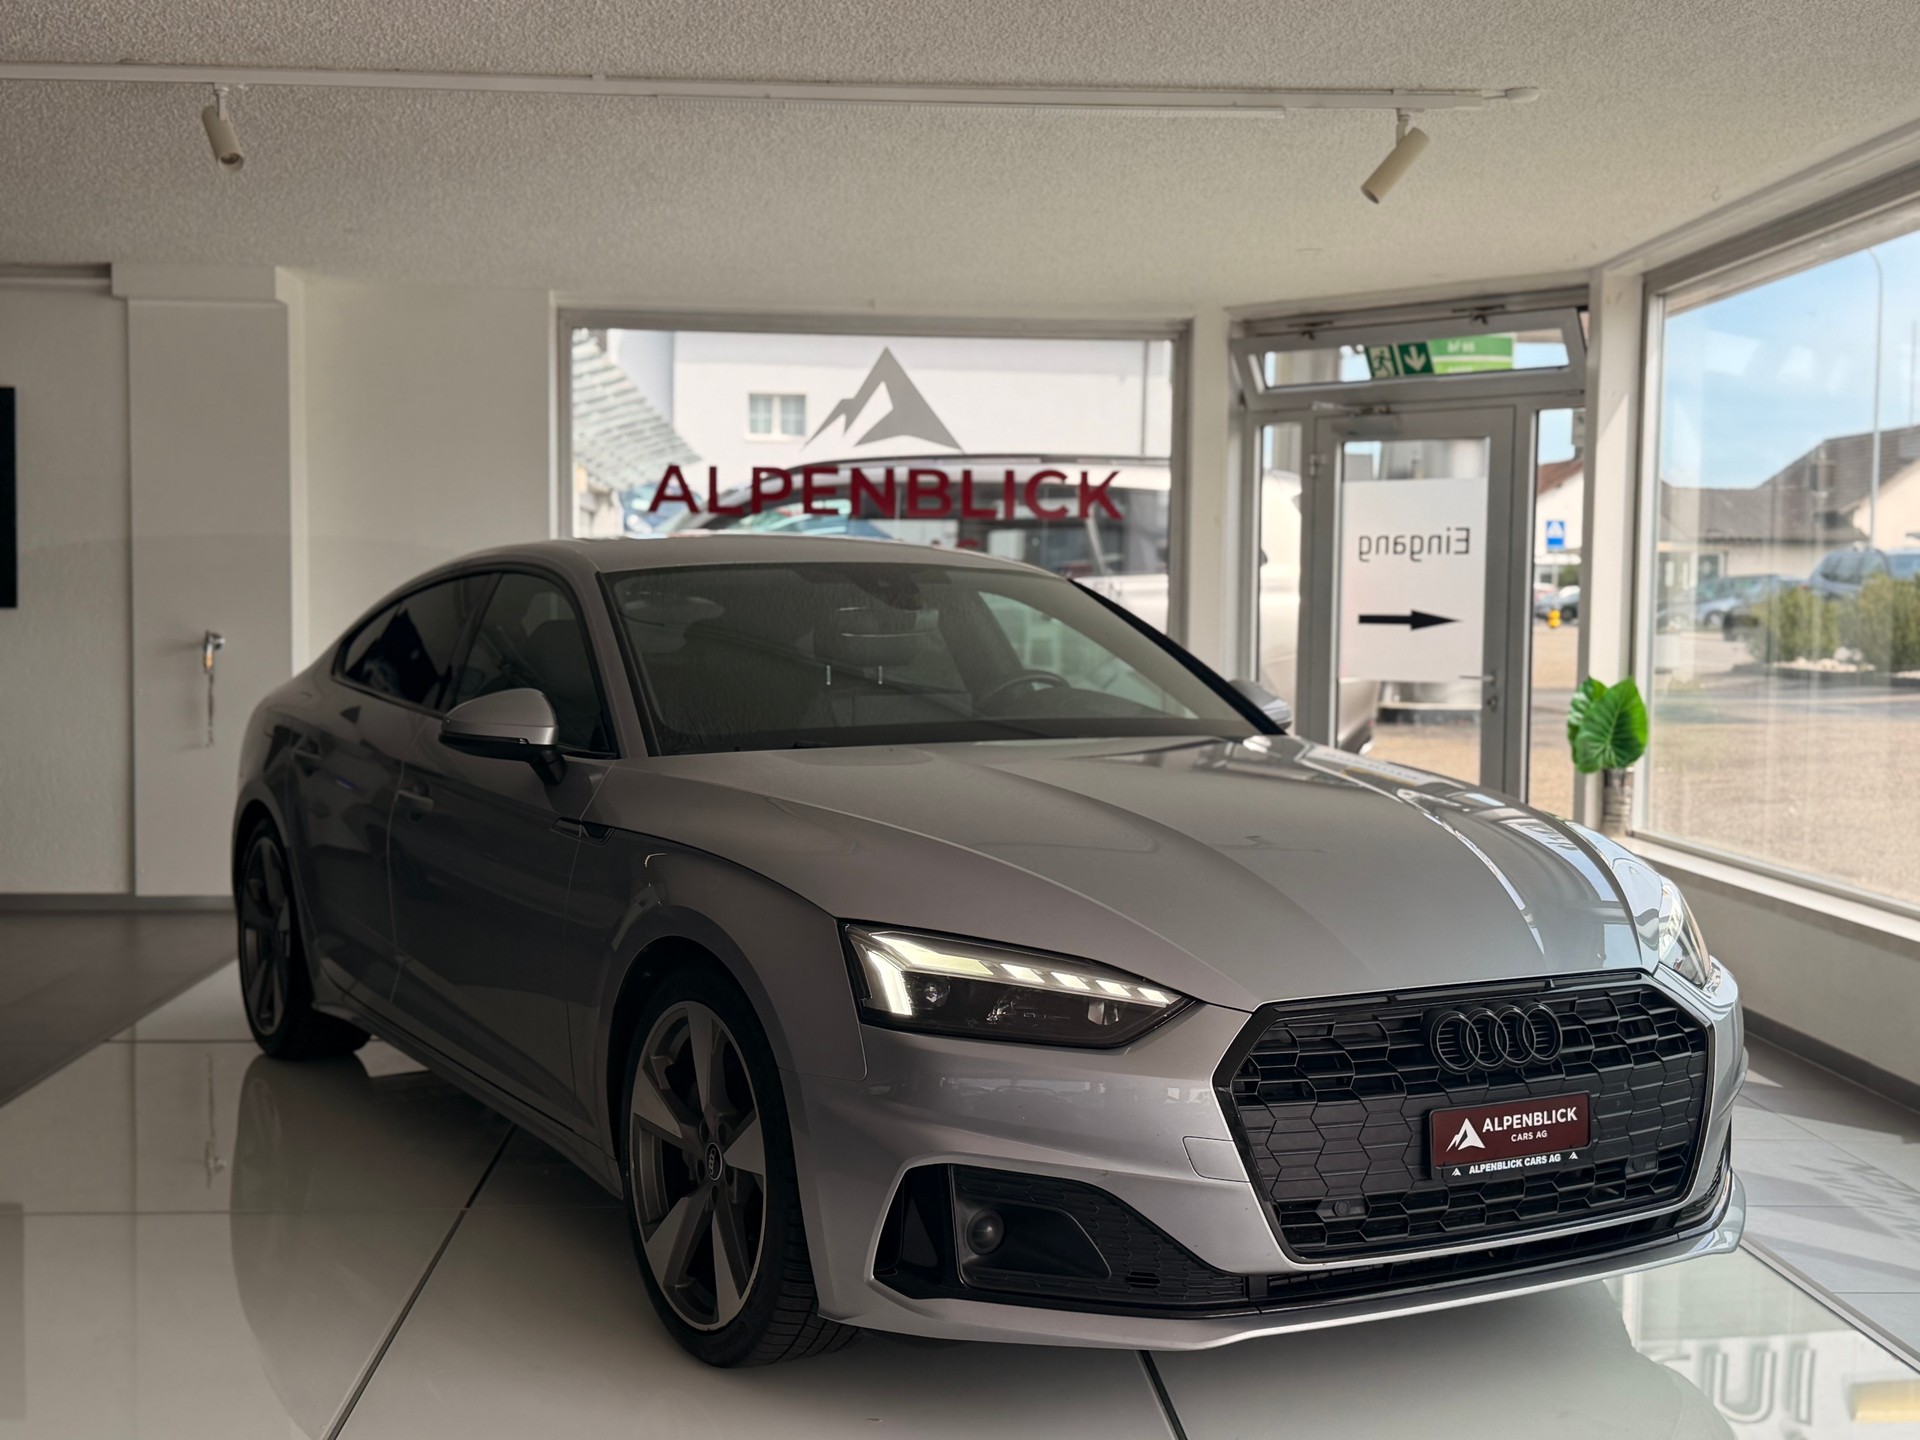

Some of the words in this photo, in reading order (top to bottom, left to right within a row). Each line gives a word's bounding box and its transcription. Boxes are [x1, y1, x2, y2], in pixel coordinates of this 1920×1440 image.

[648, 464, 1123, 521] ALPENBLICK
[1482, 1107, 1577, 1132] ALPENBLICK
[1511, 1132, 1533, 1142] CARS
[1536, 1130, 1548, 1139] AG
[1469, 1159, 1523, 1174] ALPENBLICK
[1524, 1155, 1547, 1167] CARS
[1549, 1154, 1561, 1163] AG
